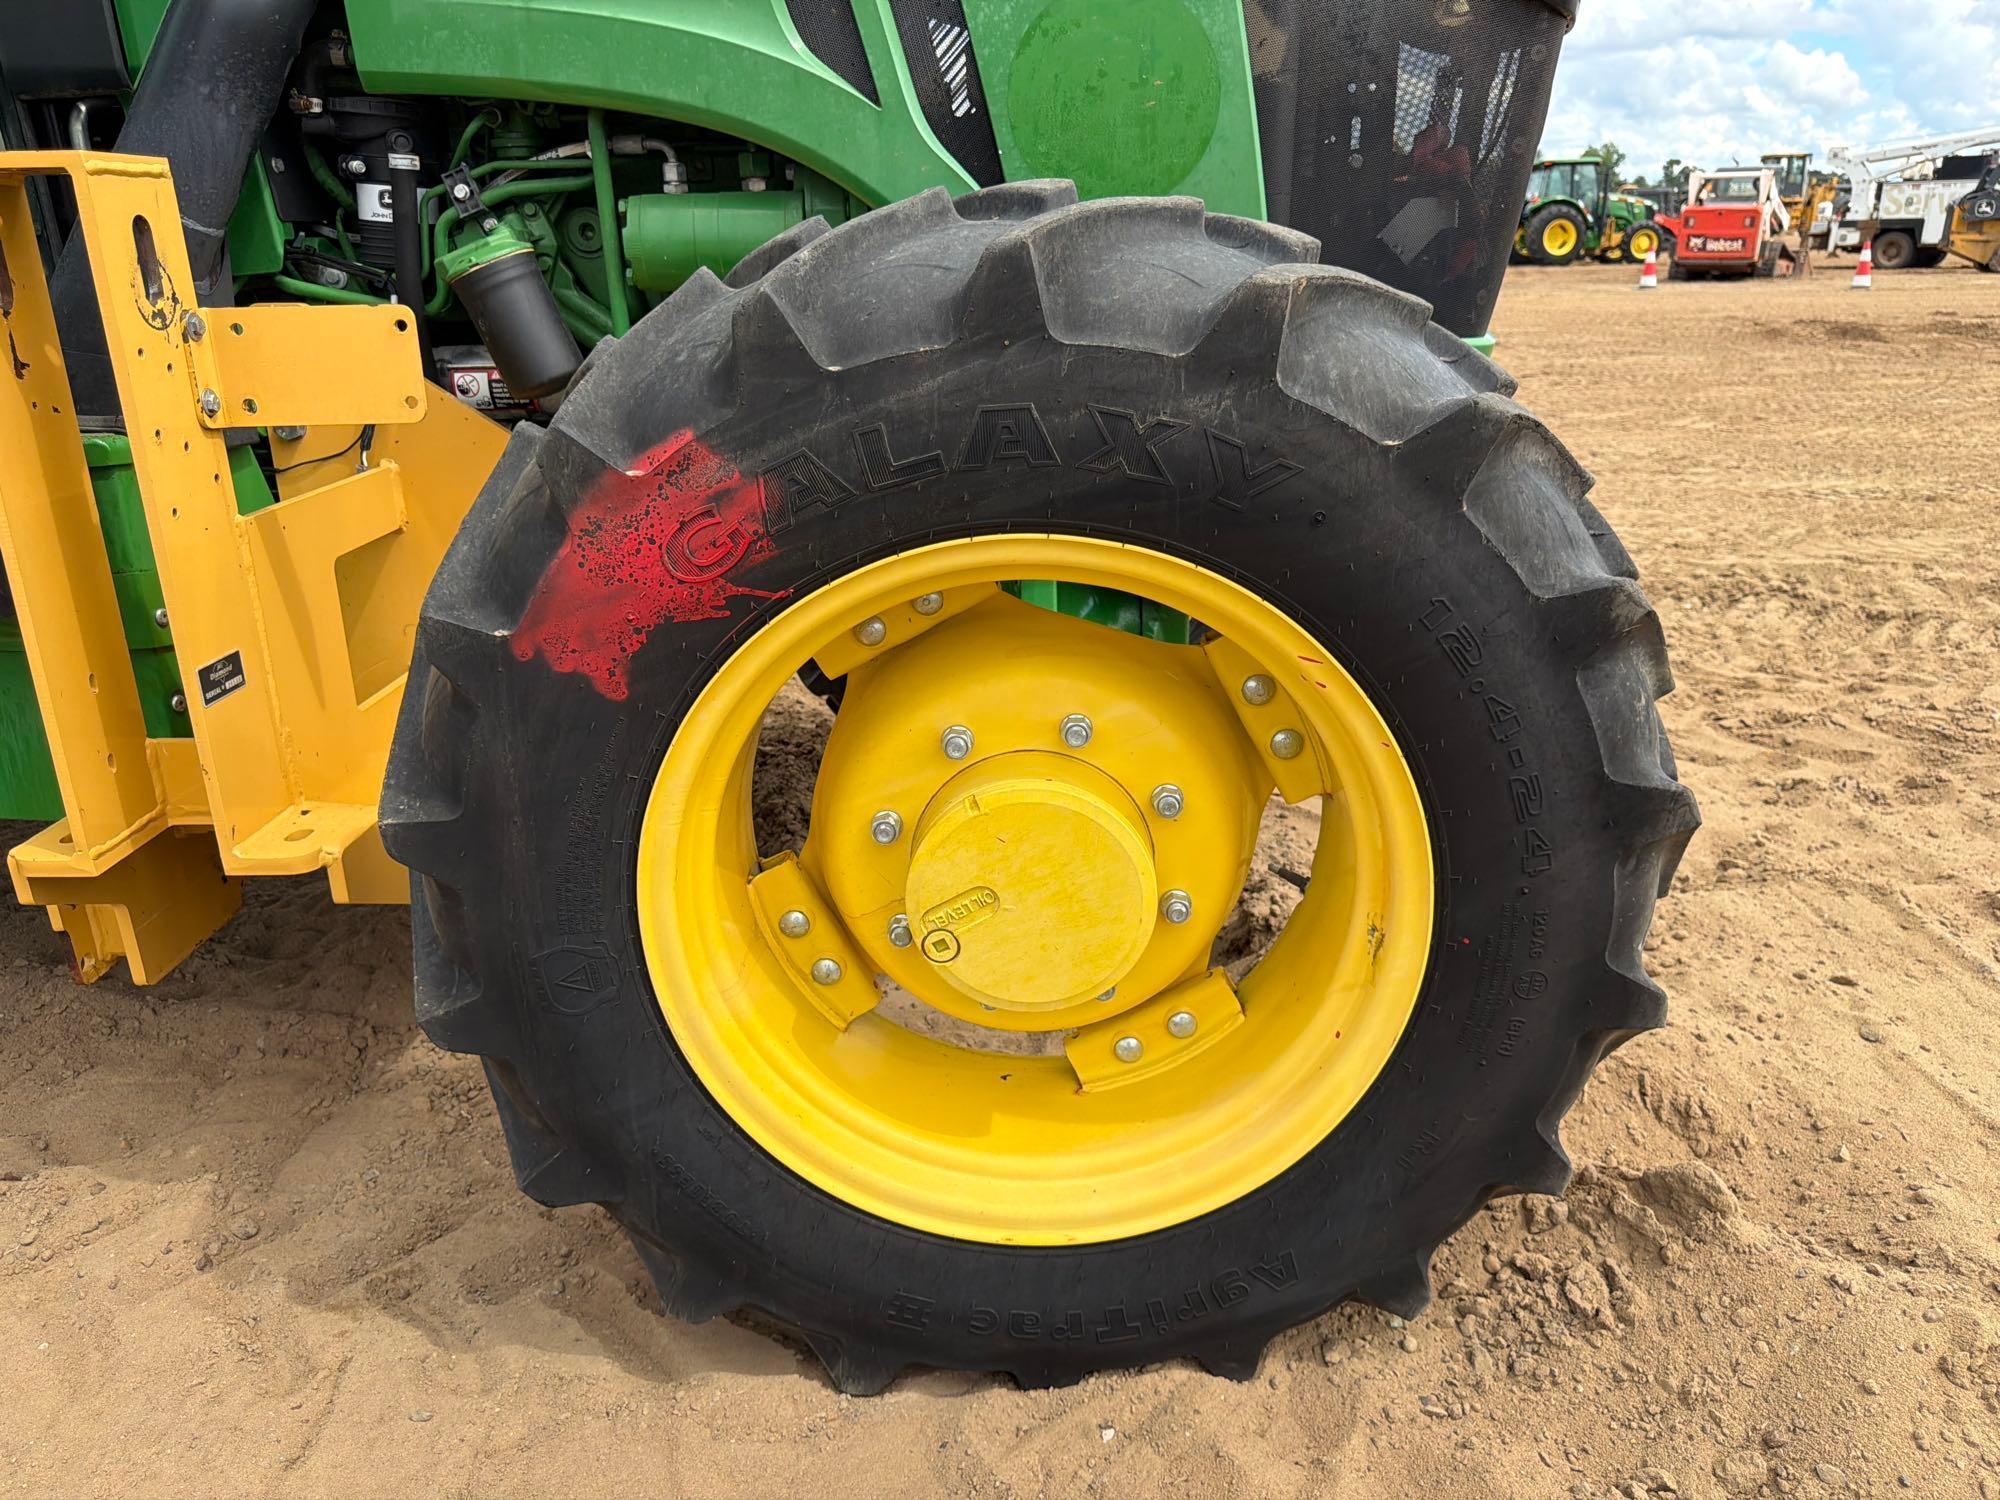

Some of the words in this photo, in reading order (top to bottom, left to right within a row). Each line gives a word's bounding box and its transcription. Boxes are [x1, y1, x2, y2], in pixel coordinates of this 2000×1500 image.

[371, 211, 388, 219] JOHN
[1705, 238, 1743, 252] Bobcat
[660, 402, 1304, 583] GALAXY
[209, 663, 233, 681] Diamond
[1419, 597, 1552, 877] 12.4-24
[931, 899, 976, 928] LEVEL
[967, 1249, 1300, 1344] AgriTrac
